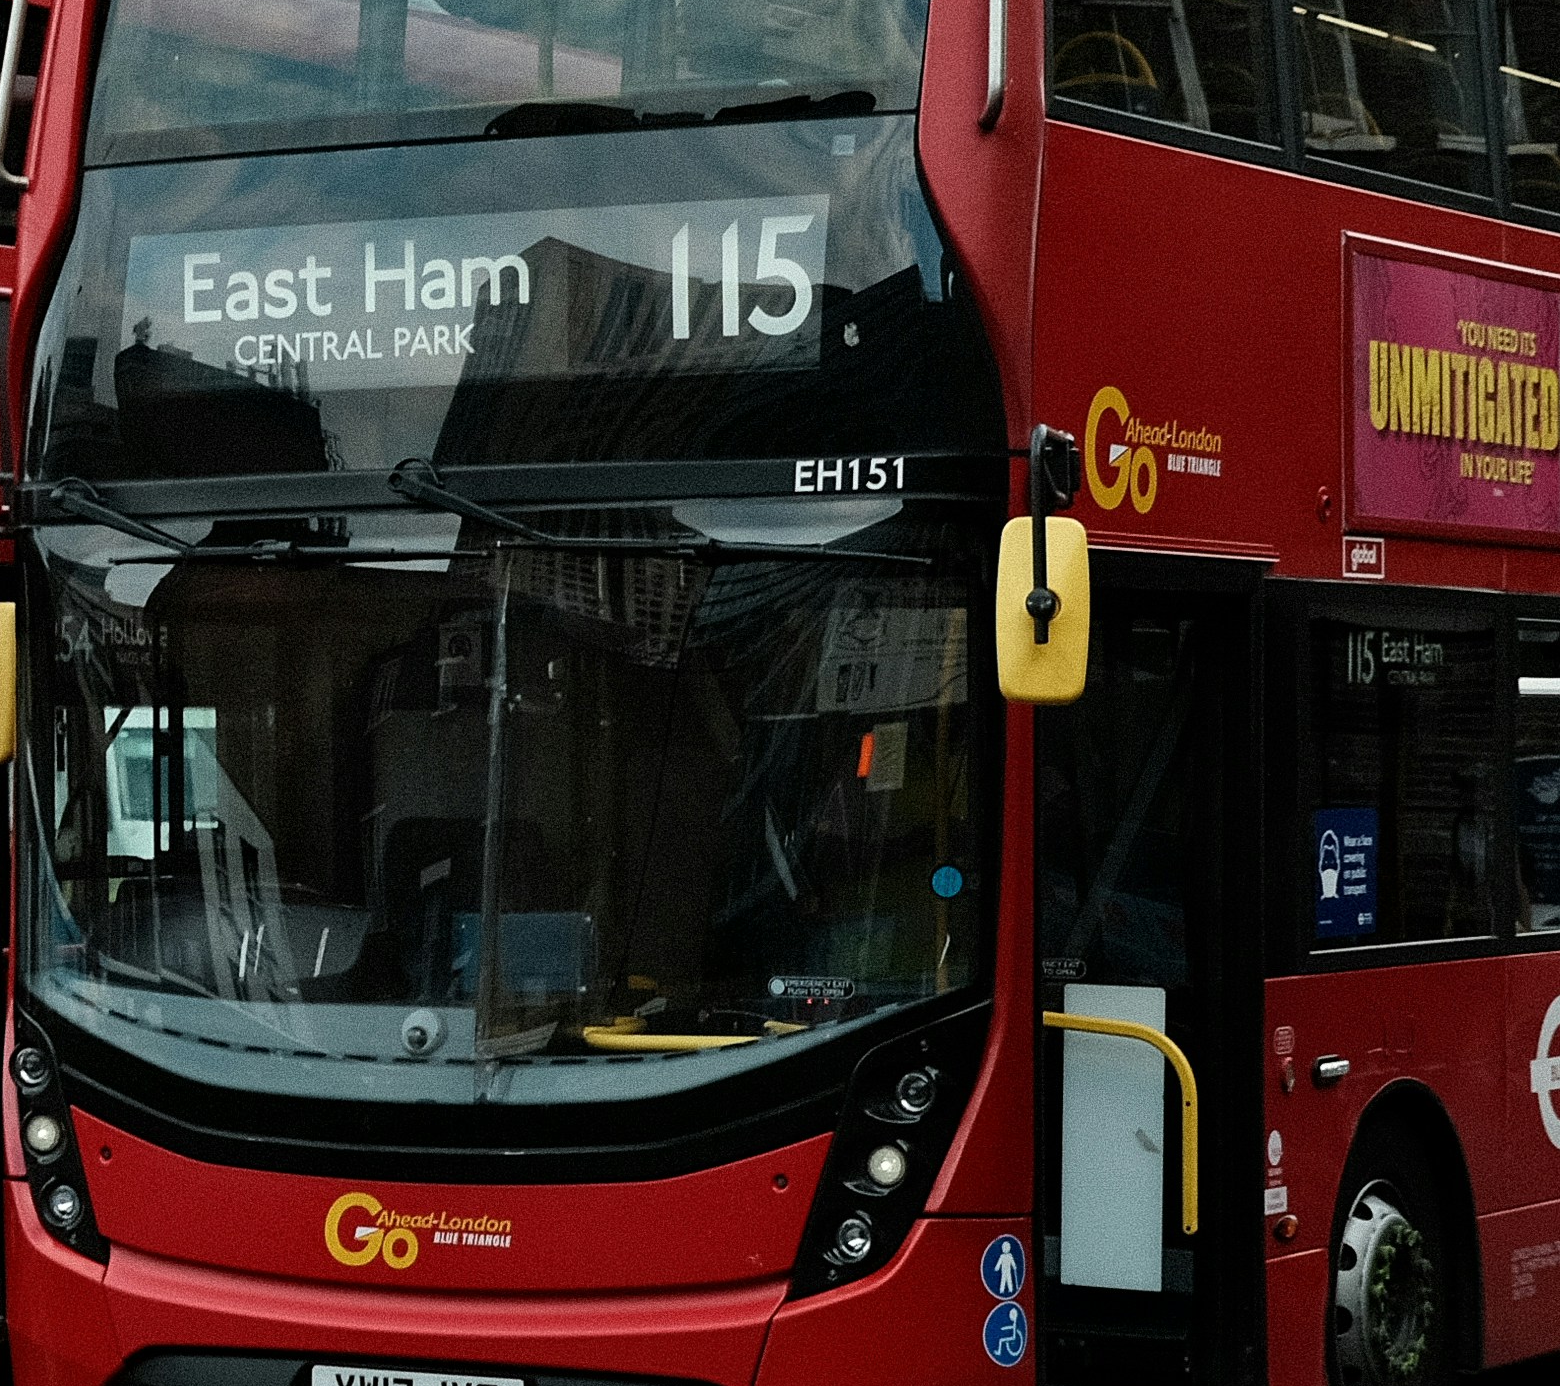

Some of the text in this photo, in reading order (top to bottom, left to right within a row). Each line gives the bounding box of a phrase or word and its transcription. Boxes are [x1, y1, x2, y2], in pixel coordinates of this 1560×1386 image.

[183, 239, 530, 323] East Ham
[672, 215, 815, 340] 115
[235, 322, 477, 367] CENTRAL PARK
[1487, 325, 1518, 354] NEED
[1519, 331, 1537, 357] ITS
[1369, 340, 1560, 451] UNMITIGATED
[1085, 386, 1157, 514] Go
[1124, 416, 1222, 454] Ahead-London
[794, 456, 905, 493] EH151
[1167, 454, 1222, 478] BLUE TRIANGLE
[1460, 452, 1474, 479] IN
[1476, 454, 1508, 482] YOUR
[1347, 629, 1376, 685] 115
[1382, 630, 1411, 664] East
[1414, 631, 1445, 666] Ham
[325, 1191, 419, 1270] Go
[375, 1209, 512, 1233] Ahead-London
[433, 1231, 512, 1248] BLUE TRIANGLE
